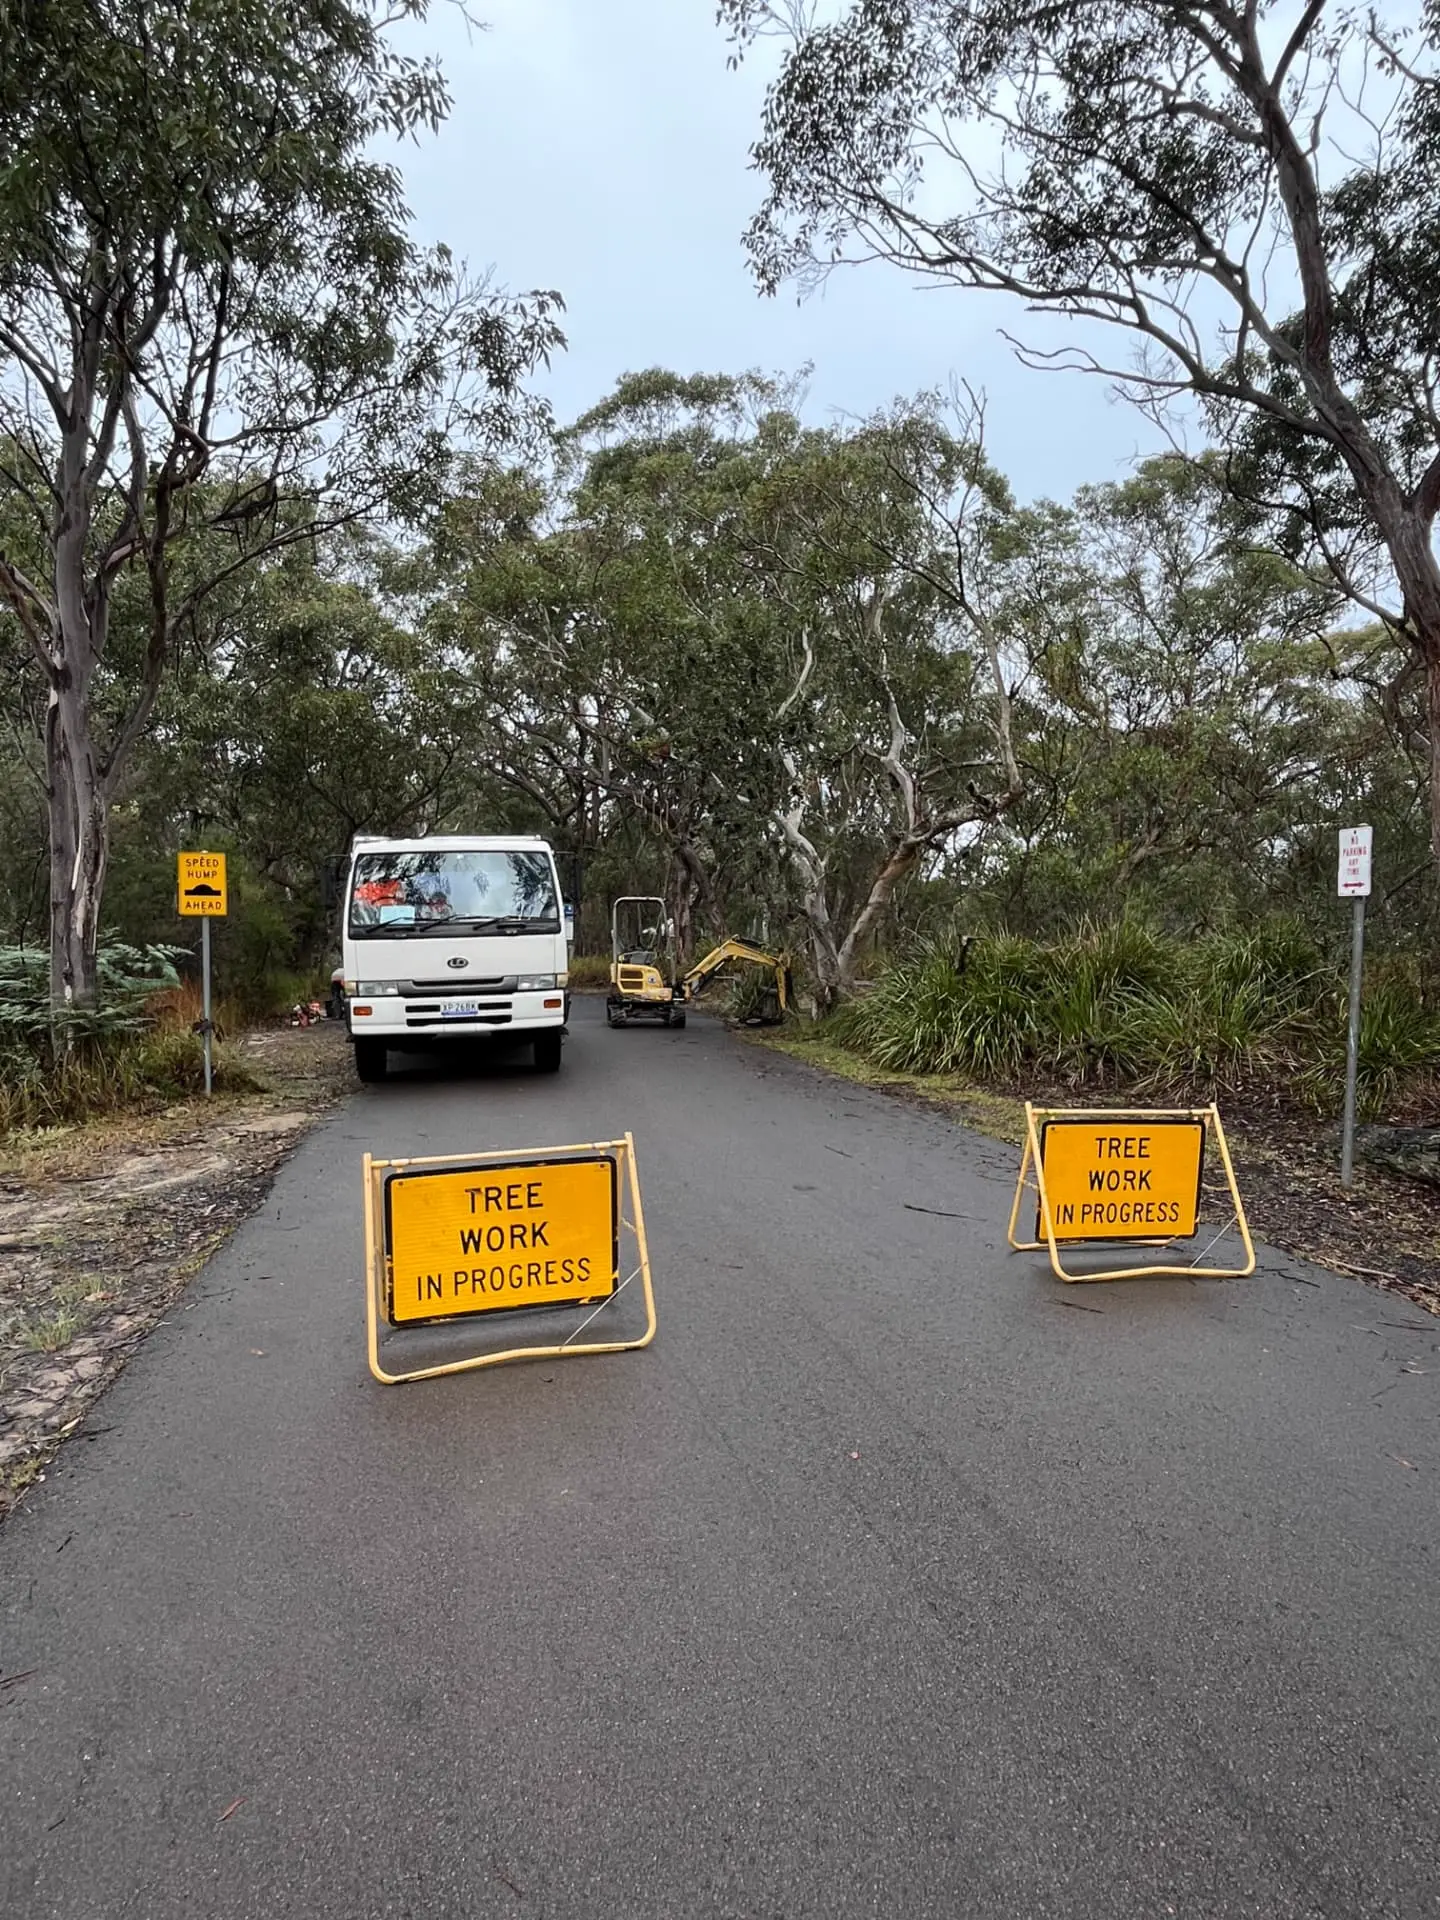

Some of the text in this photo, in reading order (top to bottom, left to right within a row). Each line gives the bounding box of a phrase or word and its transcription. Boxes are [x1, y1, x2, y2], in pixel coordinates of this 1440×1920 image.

[186, 858, 219, 868] SPEED
[1343, 847, 1367, 857] PARKING
[188, 871, 218, 879] HUMP
[186, 901, 222, 910] AHEAD
[1095, 1137, 1151, 1159] TREE
[1088, 1170, 1152, 1192] WORK
[465, 1182, 544, 1213] TREE
[1056, 1202, 1180, 1225] IN PROGRESS
[460, 1221, 549, 1255] WORK
[417, 1257, 591, 1301] IN PROGRESS
